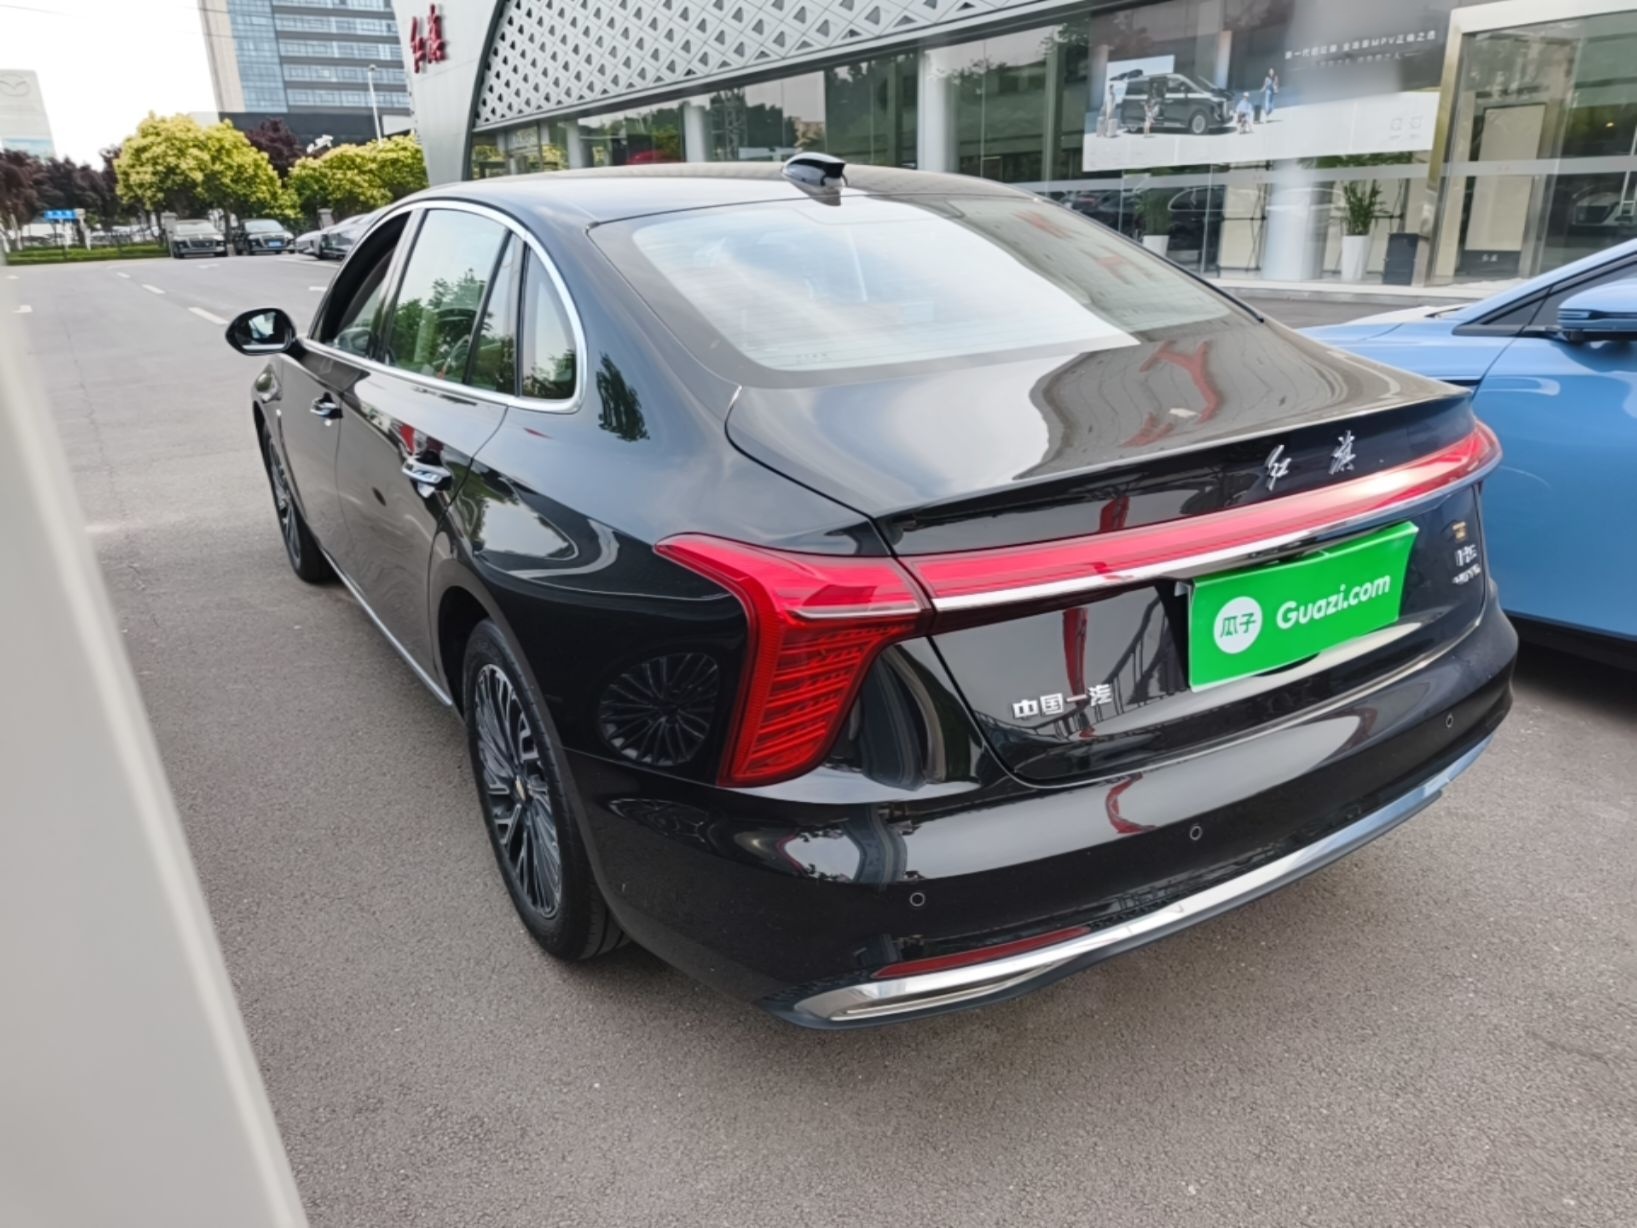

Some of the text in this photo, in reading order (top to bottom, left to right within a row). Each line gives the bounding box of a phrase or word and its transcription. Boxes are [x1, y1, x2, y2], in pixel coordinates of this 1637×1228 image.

[1276, 575, 1391, 629] Guazi.com
[1220, 612, 1257, 638] 瓜子
[1012, 684, 1113, 719] 中国一汽
